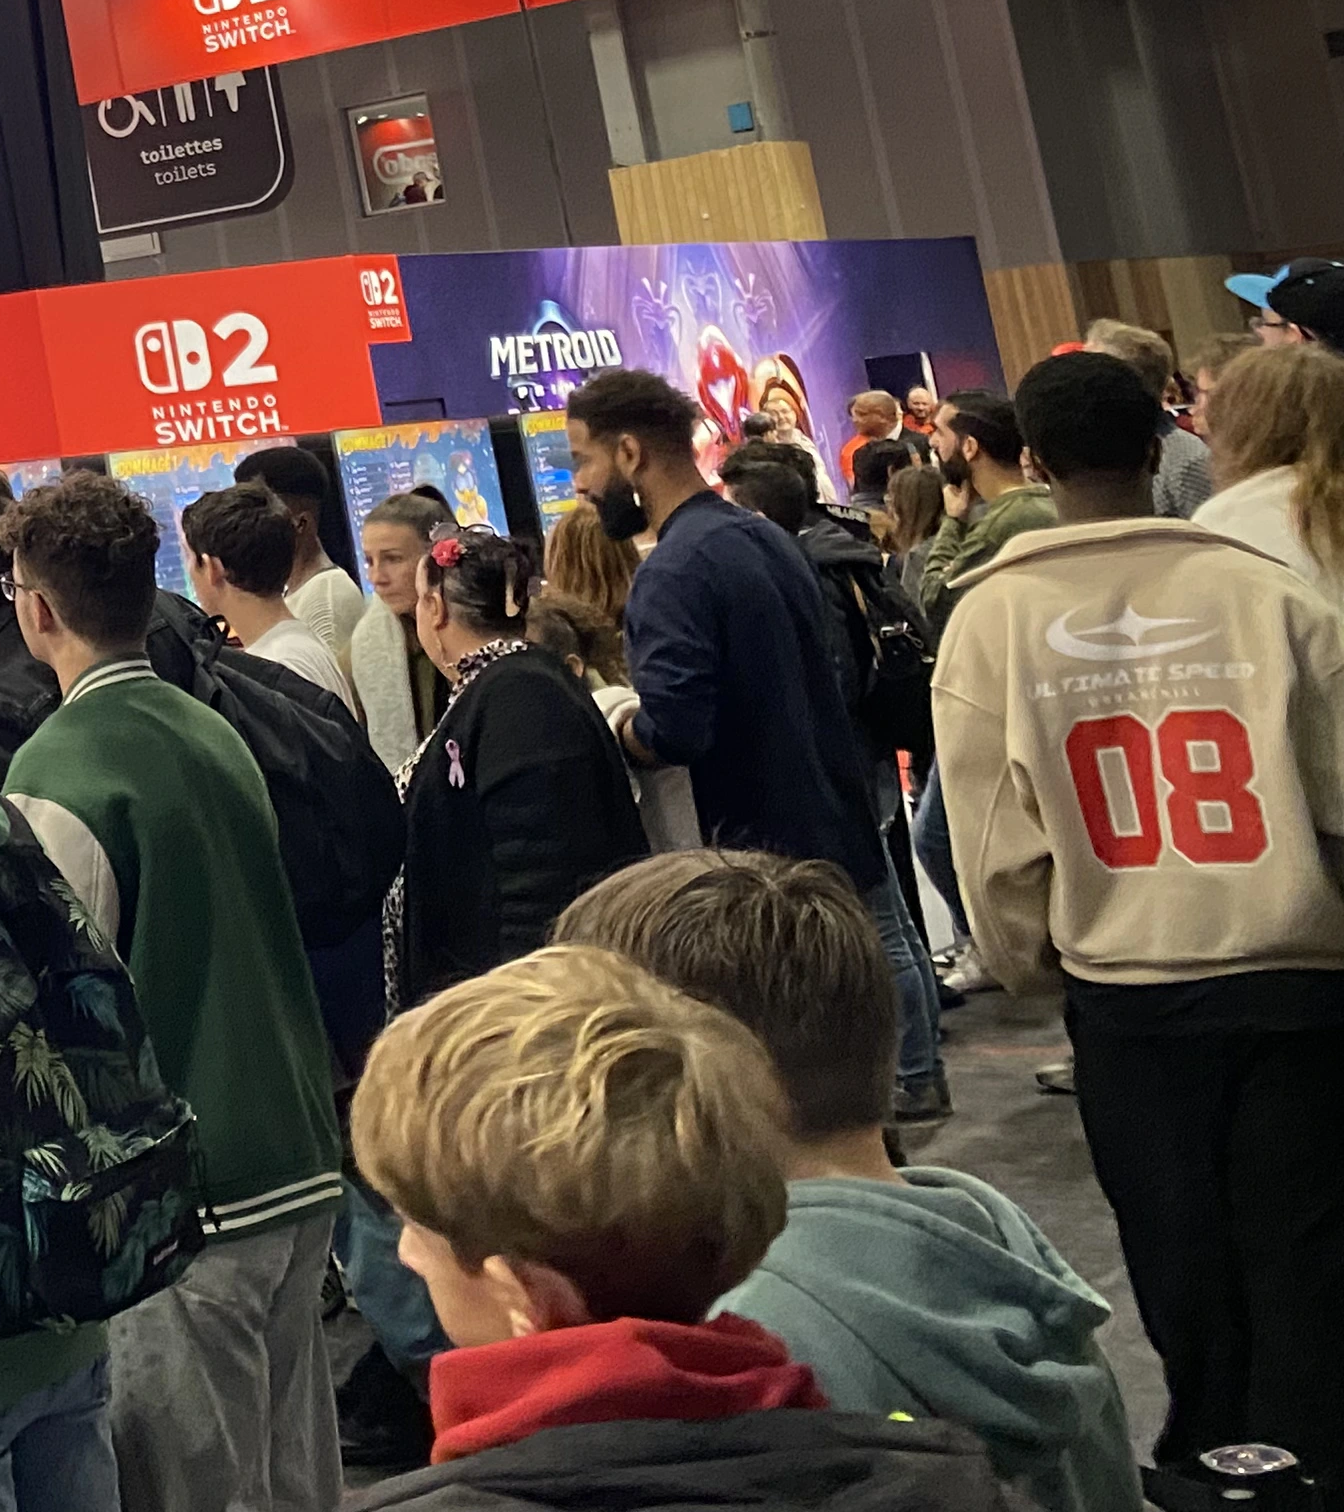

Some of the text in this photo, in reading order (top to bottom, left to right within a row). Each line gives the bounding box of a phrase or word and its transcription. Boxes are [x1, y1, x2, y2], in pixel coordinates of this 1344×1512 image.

[201, 6, 288, 35] NINTENDO
[204, 17, 292, 54] SWITCH
[139, 137, 223, 165] toilettes
[154, 162, 217, 186] toilets
[489, 328, 623, 380] METROID
[151, 393, 278, 420] NINTENDO
[154, 409, 282, 445] SWITCH
[1064, 704, 1273, 874] 08
